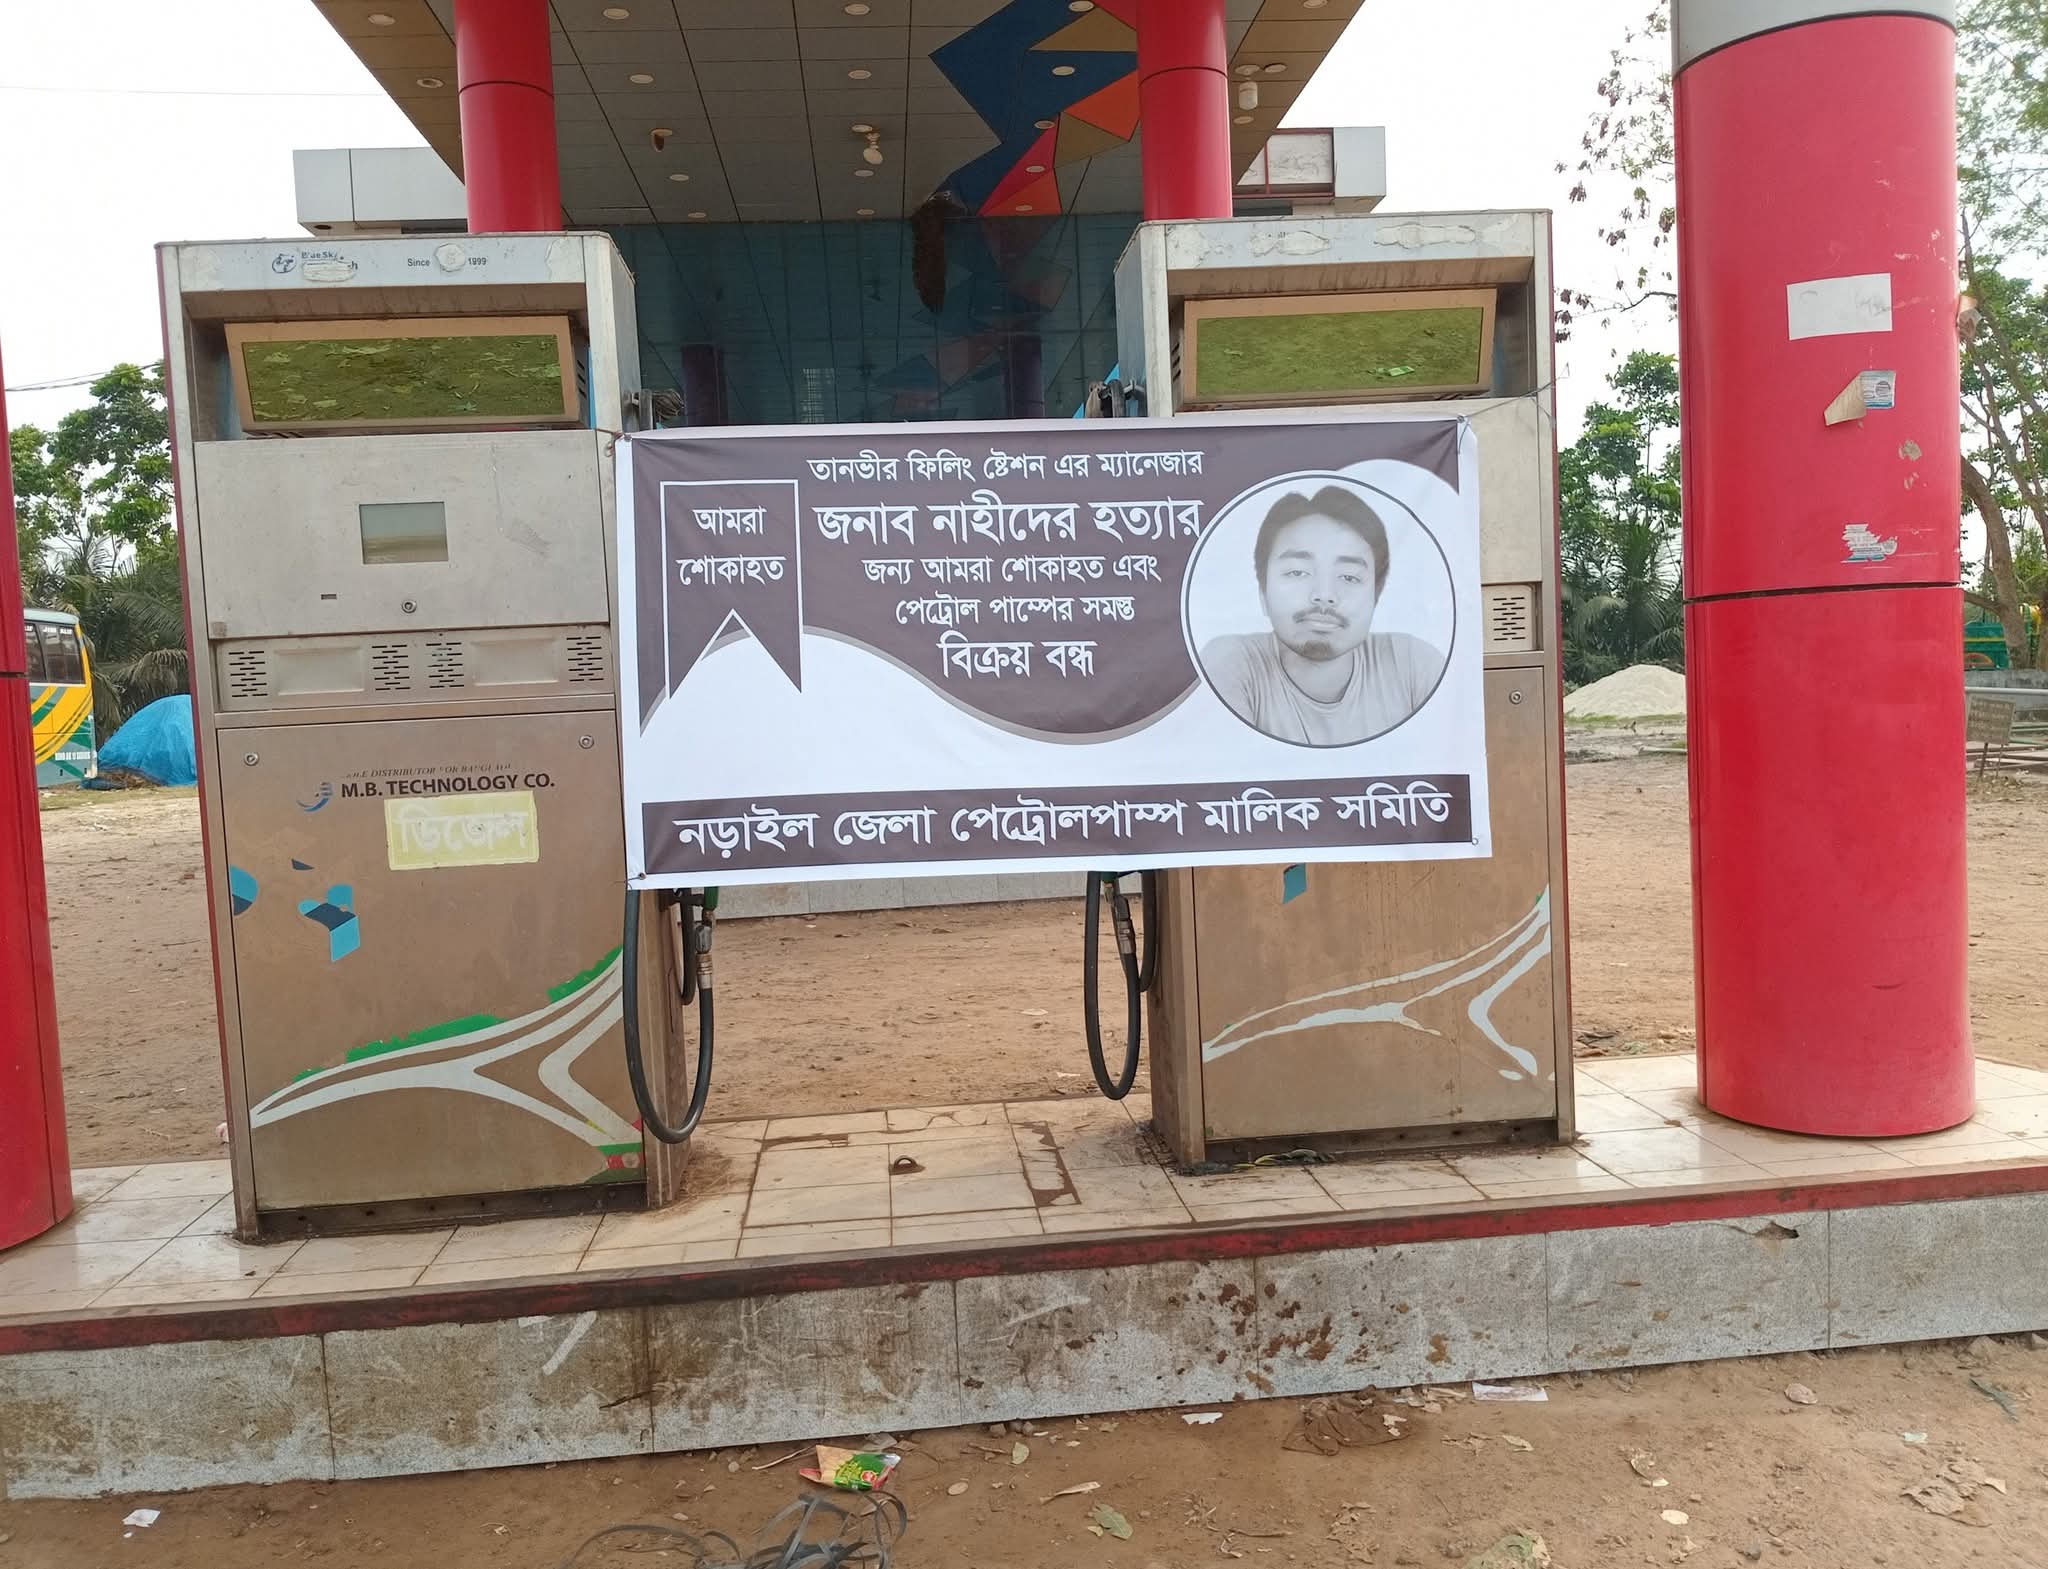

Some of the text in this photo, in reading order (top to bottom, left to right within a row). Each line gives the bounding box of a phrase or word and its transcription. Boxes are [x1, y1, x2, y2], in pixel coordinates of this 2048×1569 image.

[407, 257, 487, 267] Since 1999
[806, 449, 901, 483] তানভীর
[904, 448, 976, 482] ফিলিং
[1054, 454, 1091, 478] এর
[1095, 449, 1205, 478] ম্যানেজার
[692, 505, 767, 535] আমরা
[811, 488, 1205, 546] জনাব নাহীদের হত্যার
[675, 553, 787, 586] শোকাহত
[861, 554, 1162, 585] জন্য আমরা শোকাহত এবং
[895, 590, 1136, 628] পেট্রোল পাম্পের সমস্ত
[935, 629, 1098, 679] বিক্রয় বন্ধ
[341, 781, 383, 798] M.B.
[385, 773, 519, 796] TECHNOLOGY
[523, 772, 556, 788] CO.
[672, 780, 1453, 859] নড়াইল জেলা পেট্রোলপাম্প মালিক সমিতি
